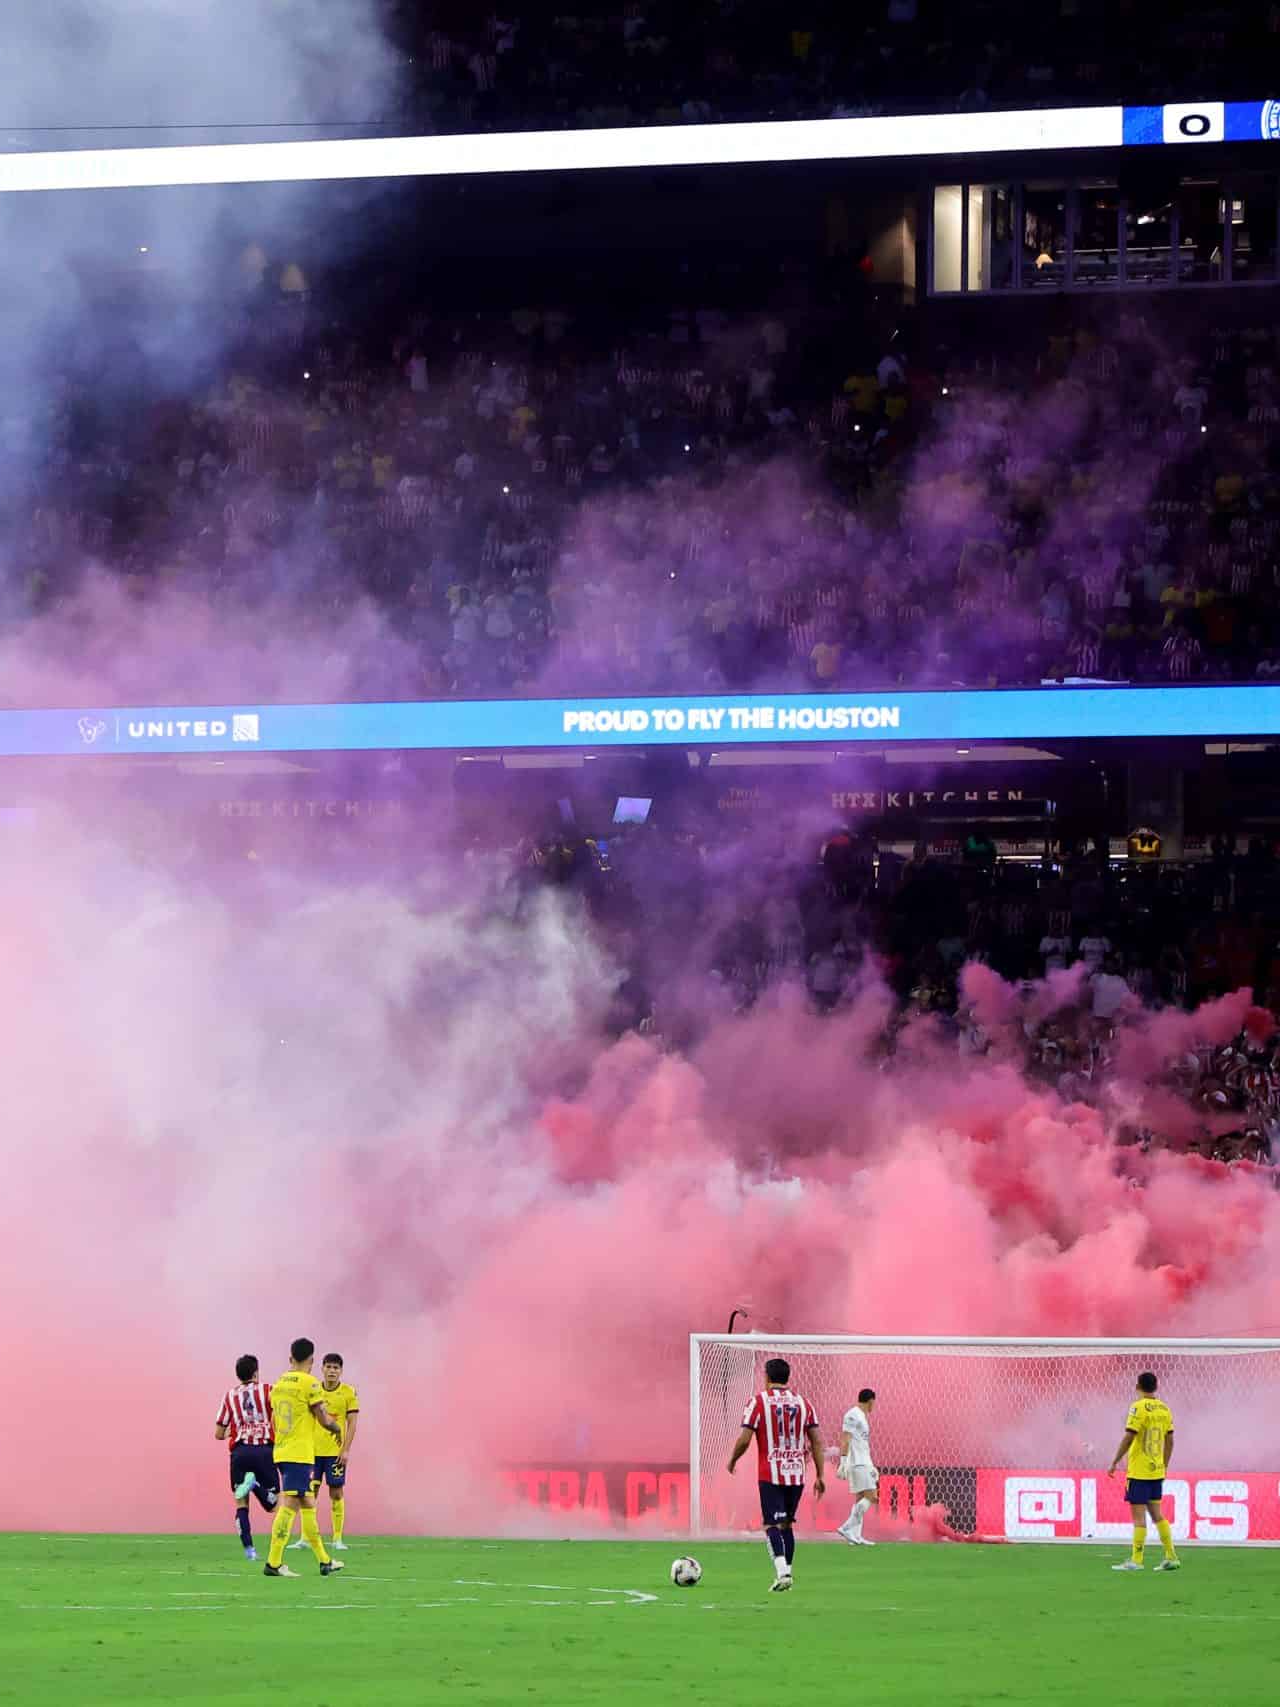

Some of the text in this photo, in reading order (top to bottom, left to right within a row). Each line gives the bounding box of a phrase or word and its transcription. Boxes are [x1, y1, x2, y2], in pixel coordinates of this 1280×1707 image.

[562, 706, 900, 732] PROUD TO FLY THE HOUSTON
[128, 721, 227, 738] UNITED
[831, 792, 876, 809] HTX
